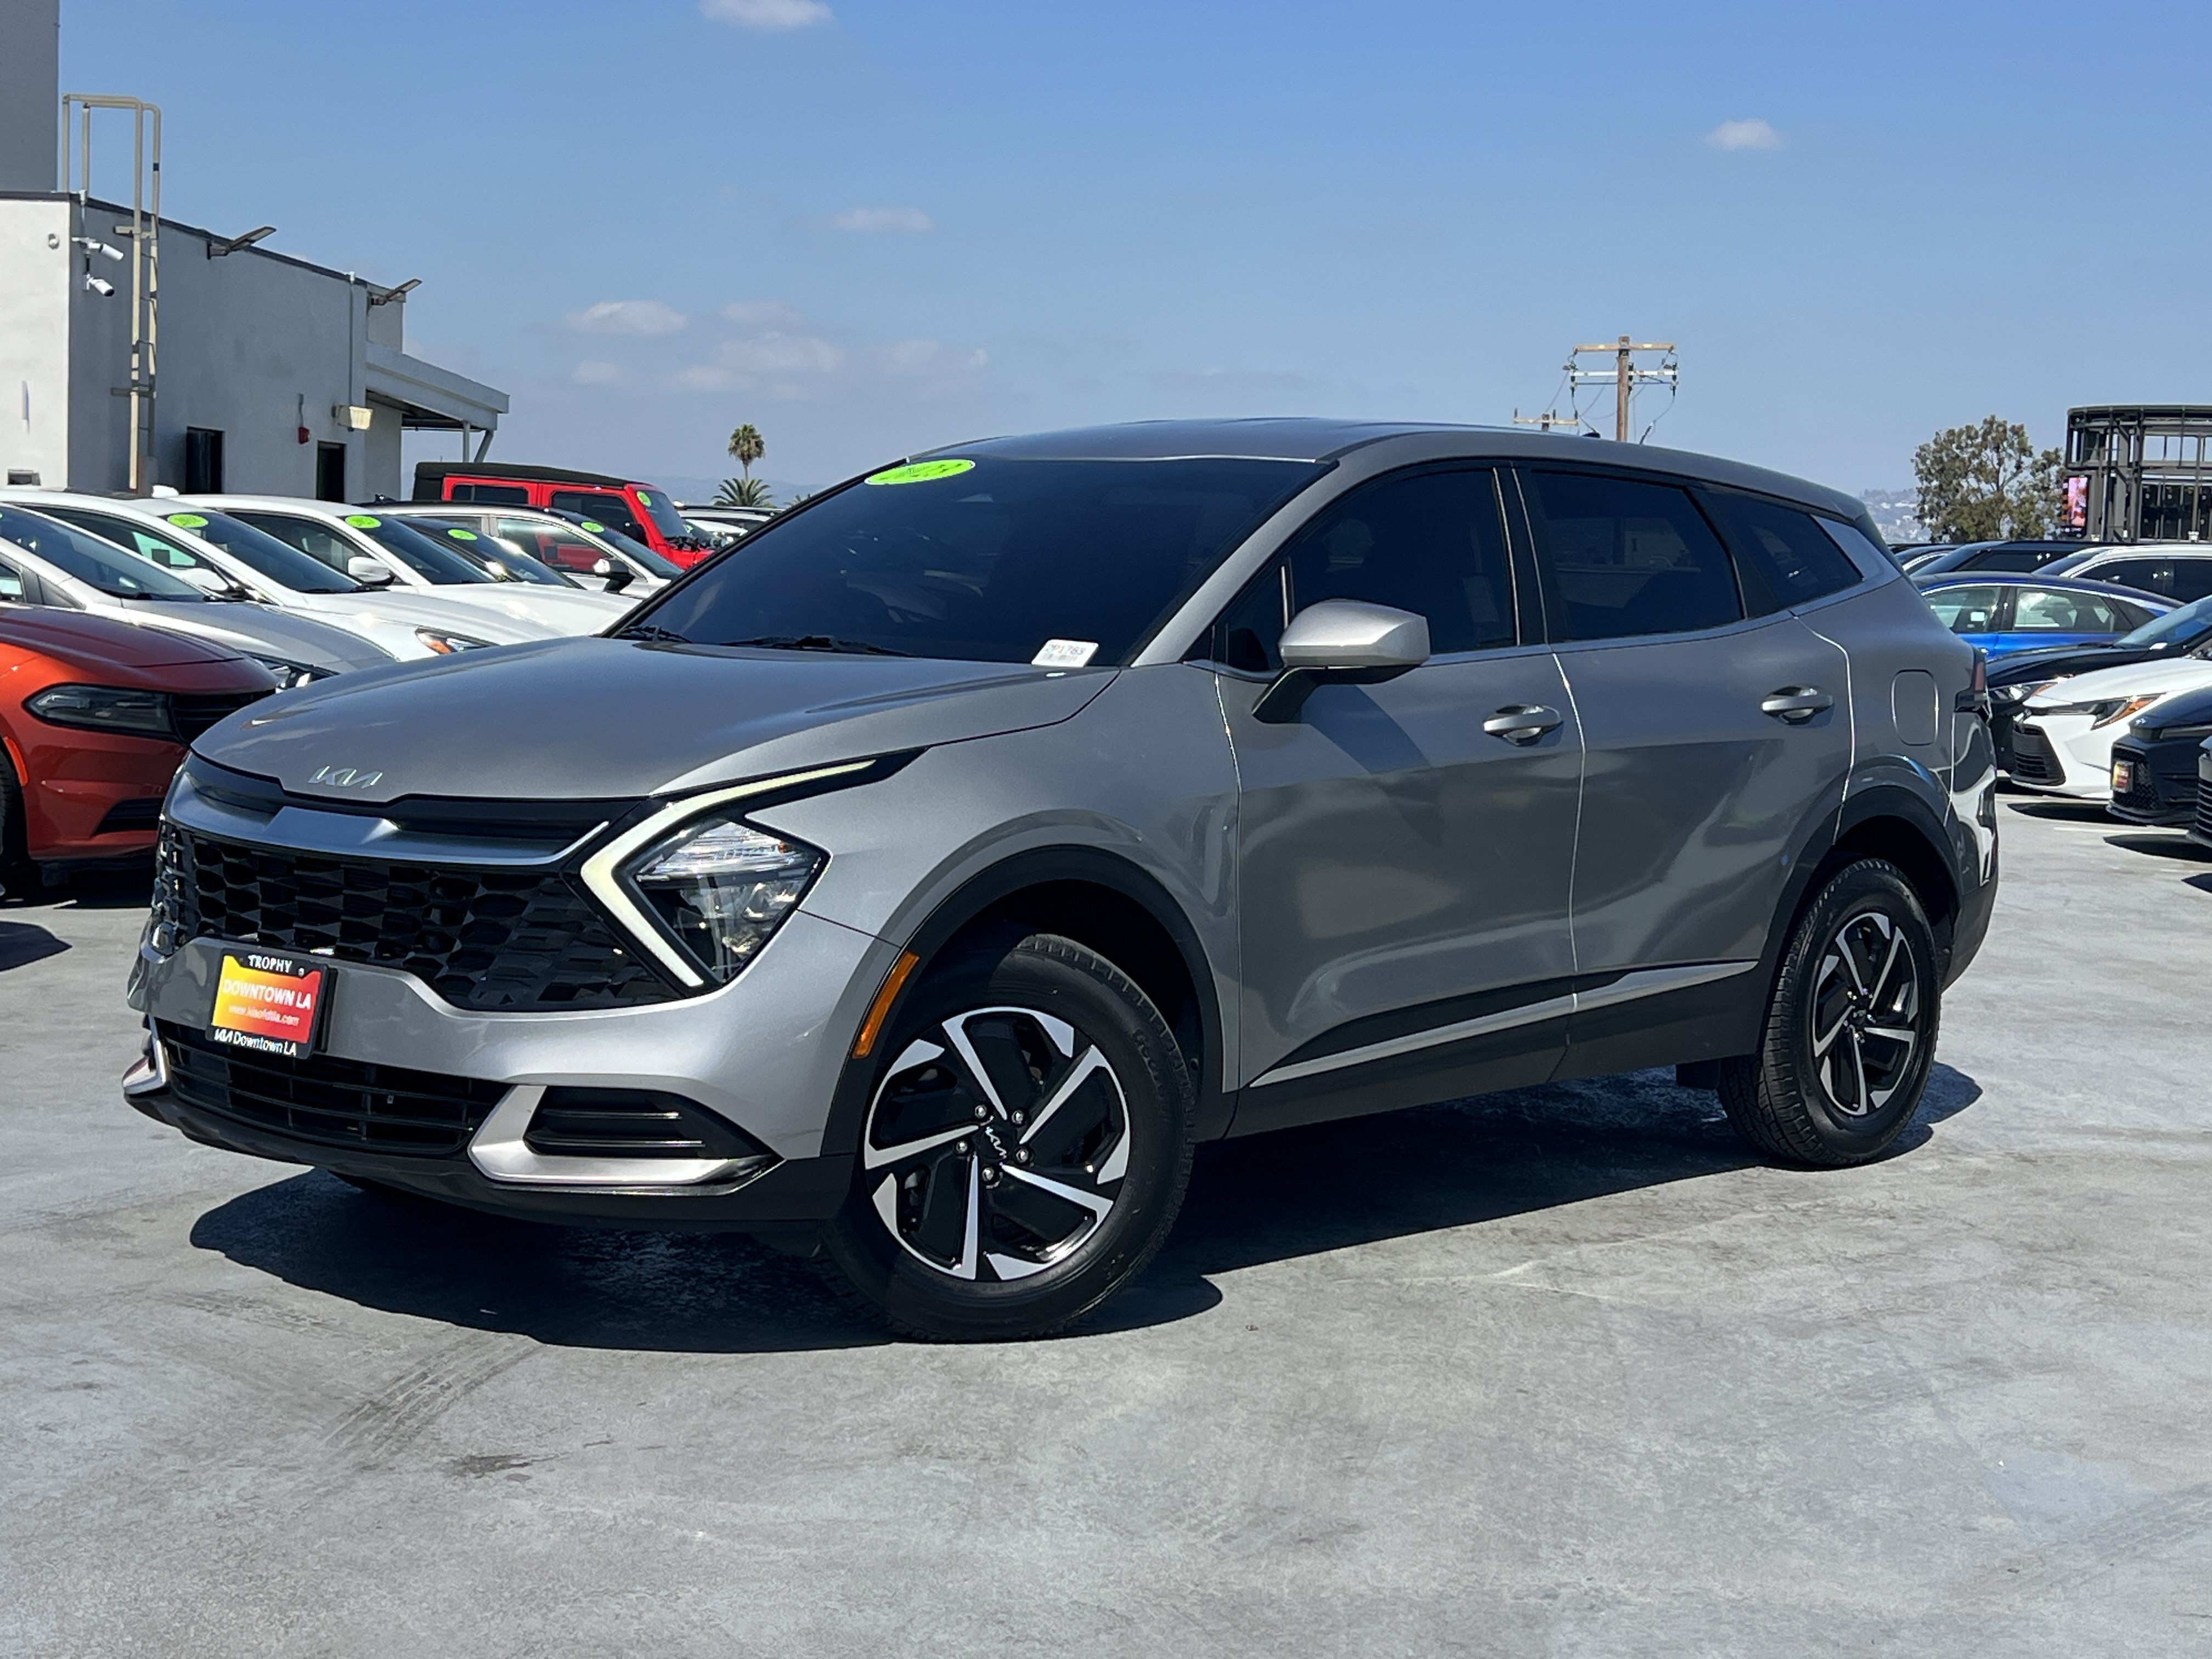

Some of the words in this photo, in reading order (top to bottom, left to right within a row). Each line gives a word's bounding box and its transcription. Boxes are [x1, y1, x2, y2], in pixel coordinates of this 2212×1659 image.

[247, 955, 292, 973] TROPHY
[222, 979, 295, 1007] DOWNTOWN
[295, 992, 311, 1011] LA
[233, 1031, 283, 1053] Downtown
[283, 1041, 297, 1057] LA
